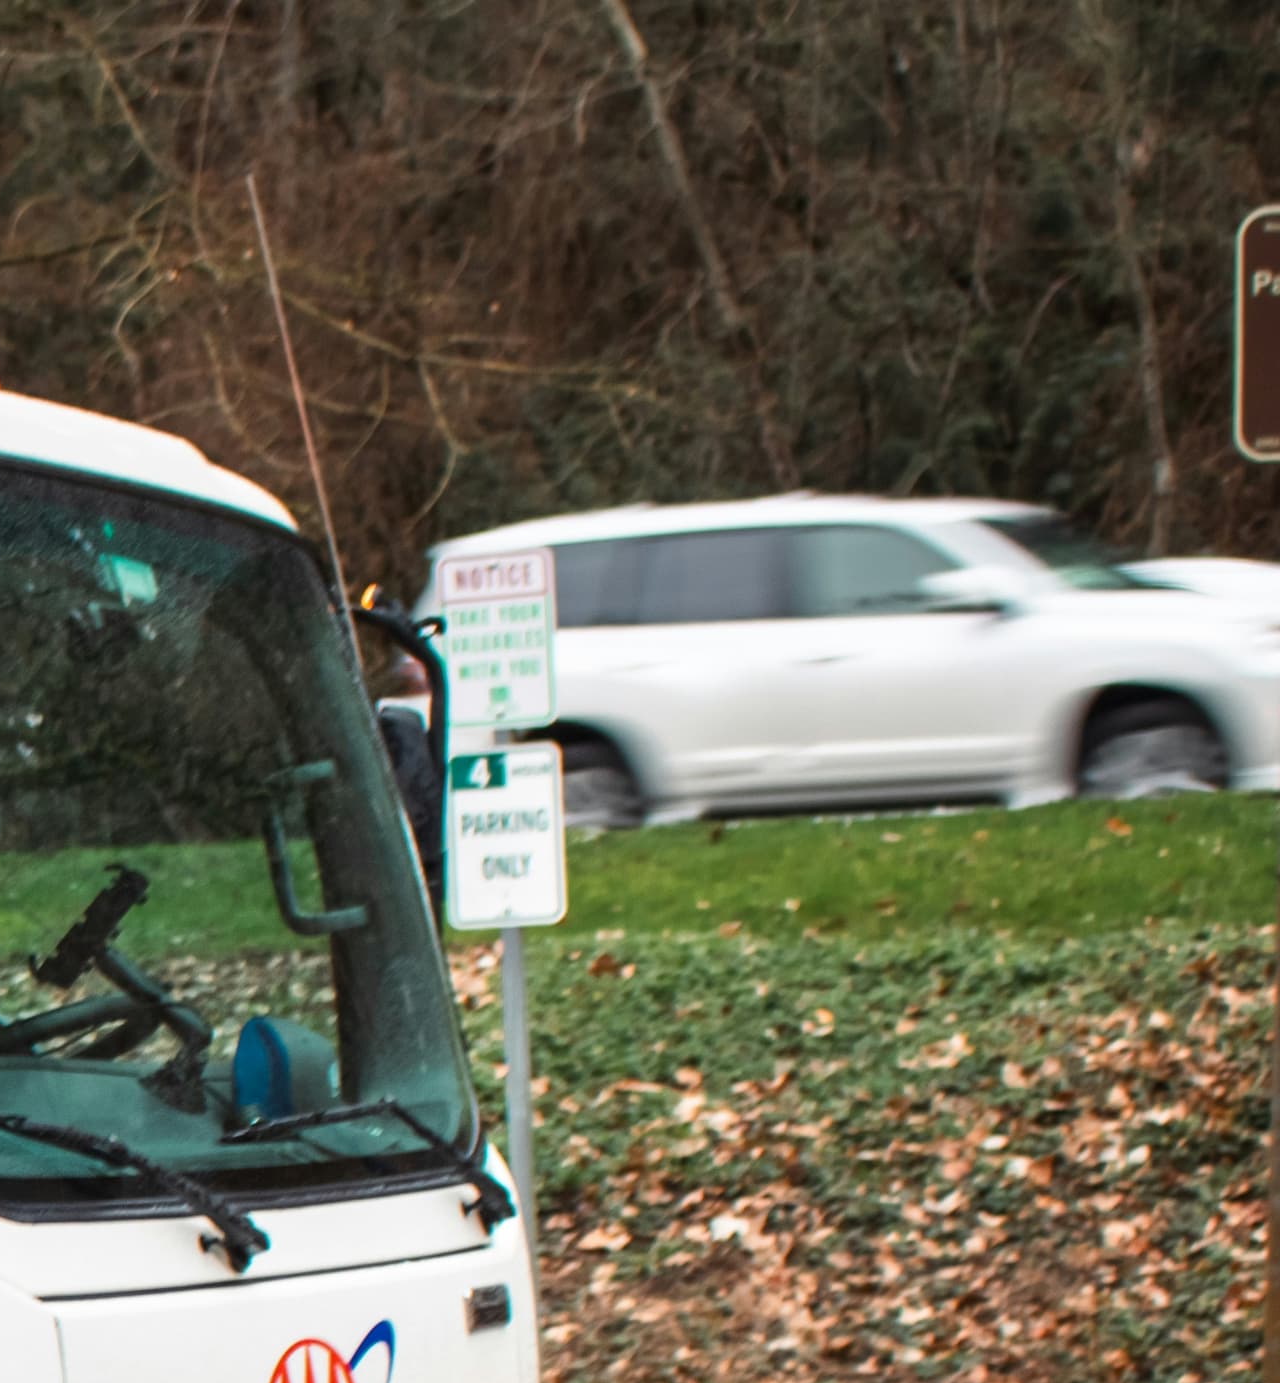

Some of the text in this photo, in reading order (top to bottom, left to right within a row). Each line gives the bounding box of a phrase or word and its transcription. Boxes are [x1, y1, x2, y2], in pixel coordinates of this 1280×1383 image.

[454, 562, 534, 593] NOTICE
[468, 756, 491, 789] 4
[460, 807, 549, 835] PARKING
[481, 852, 533, 881] ONLY
